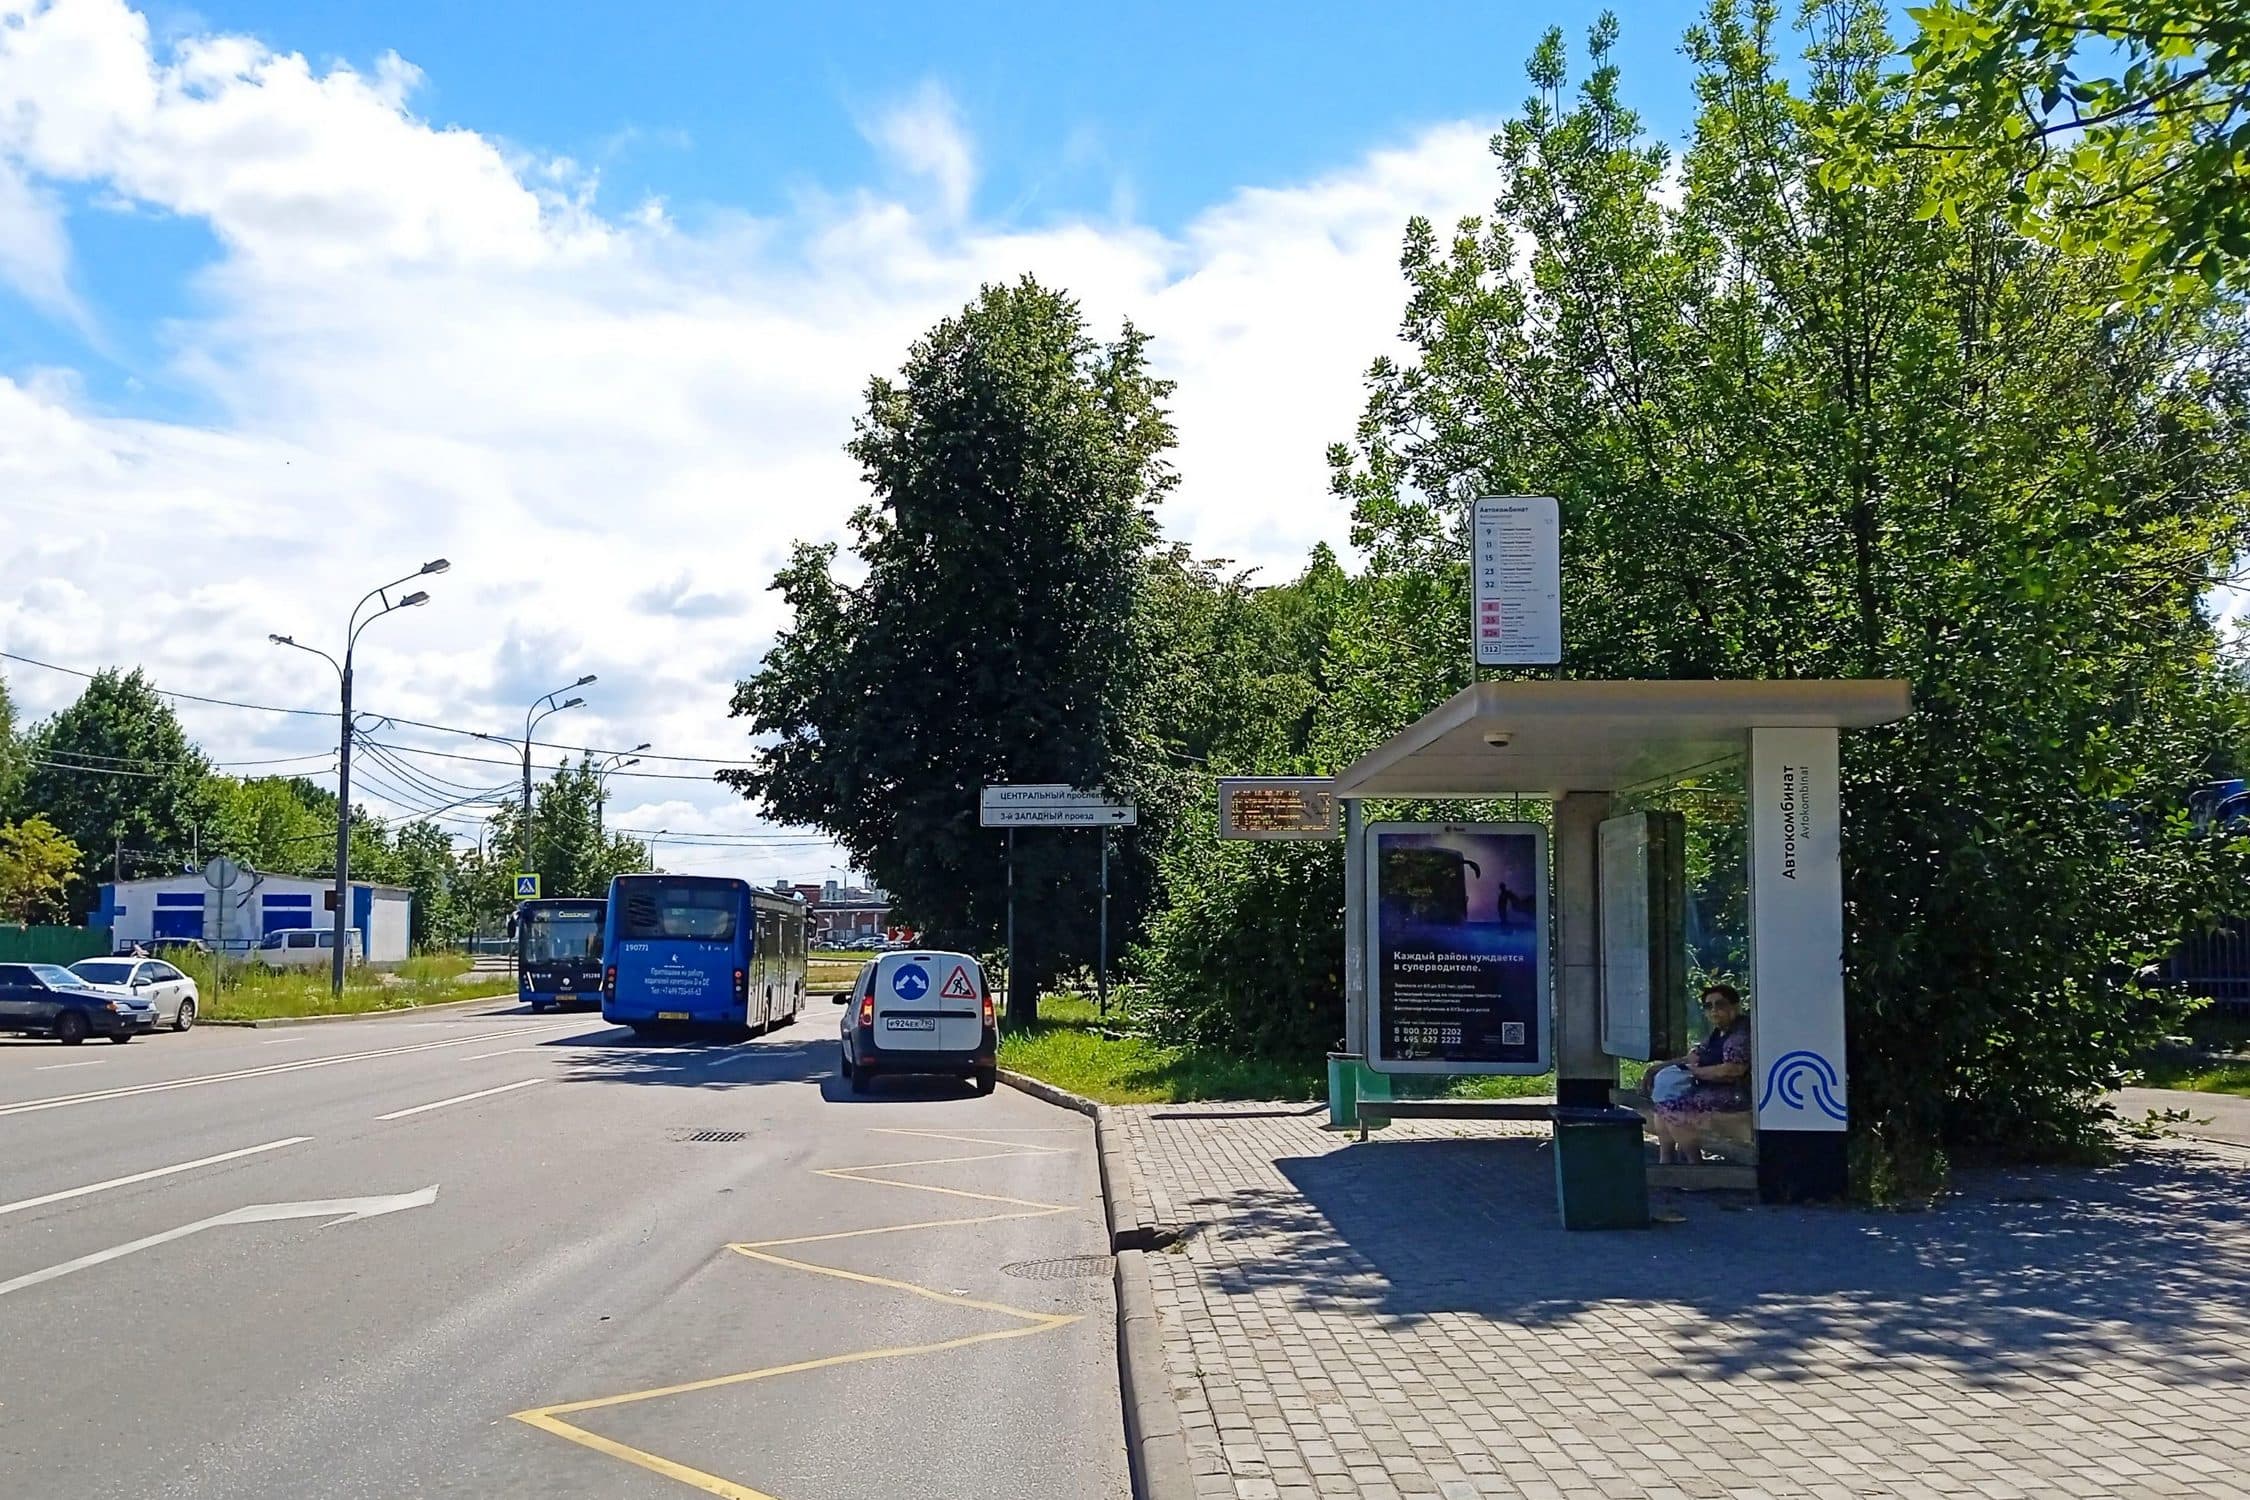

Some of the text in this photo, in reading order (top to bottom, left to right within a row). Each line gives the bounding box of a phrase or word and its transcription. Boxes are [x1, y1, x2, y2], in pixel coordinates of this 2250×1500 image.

[1000, 790, 1103, 800] ЦЕНТРАЛЬНЫЙ проспек
[1001, 811, 1094, 821] 3-й ЗАПАДНЫЙ проезд
[1780, 765, 1796, 880] Автокомбинат
[1393, 951, 1524, 963] Каждый район нуждается
[1402, 963, 1481, 973] суперводителе.
[1403, 1027, 1420, 1035] 800
[1422, 1027, 1438, 1035] 220
[1441, 1027, 1462, 1035] 2202
[1403, 1035, 1419, 1043] 495
[1441, 1036, 1461, 1044] 2222
